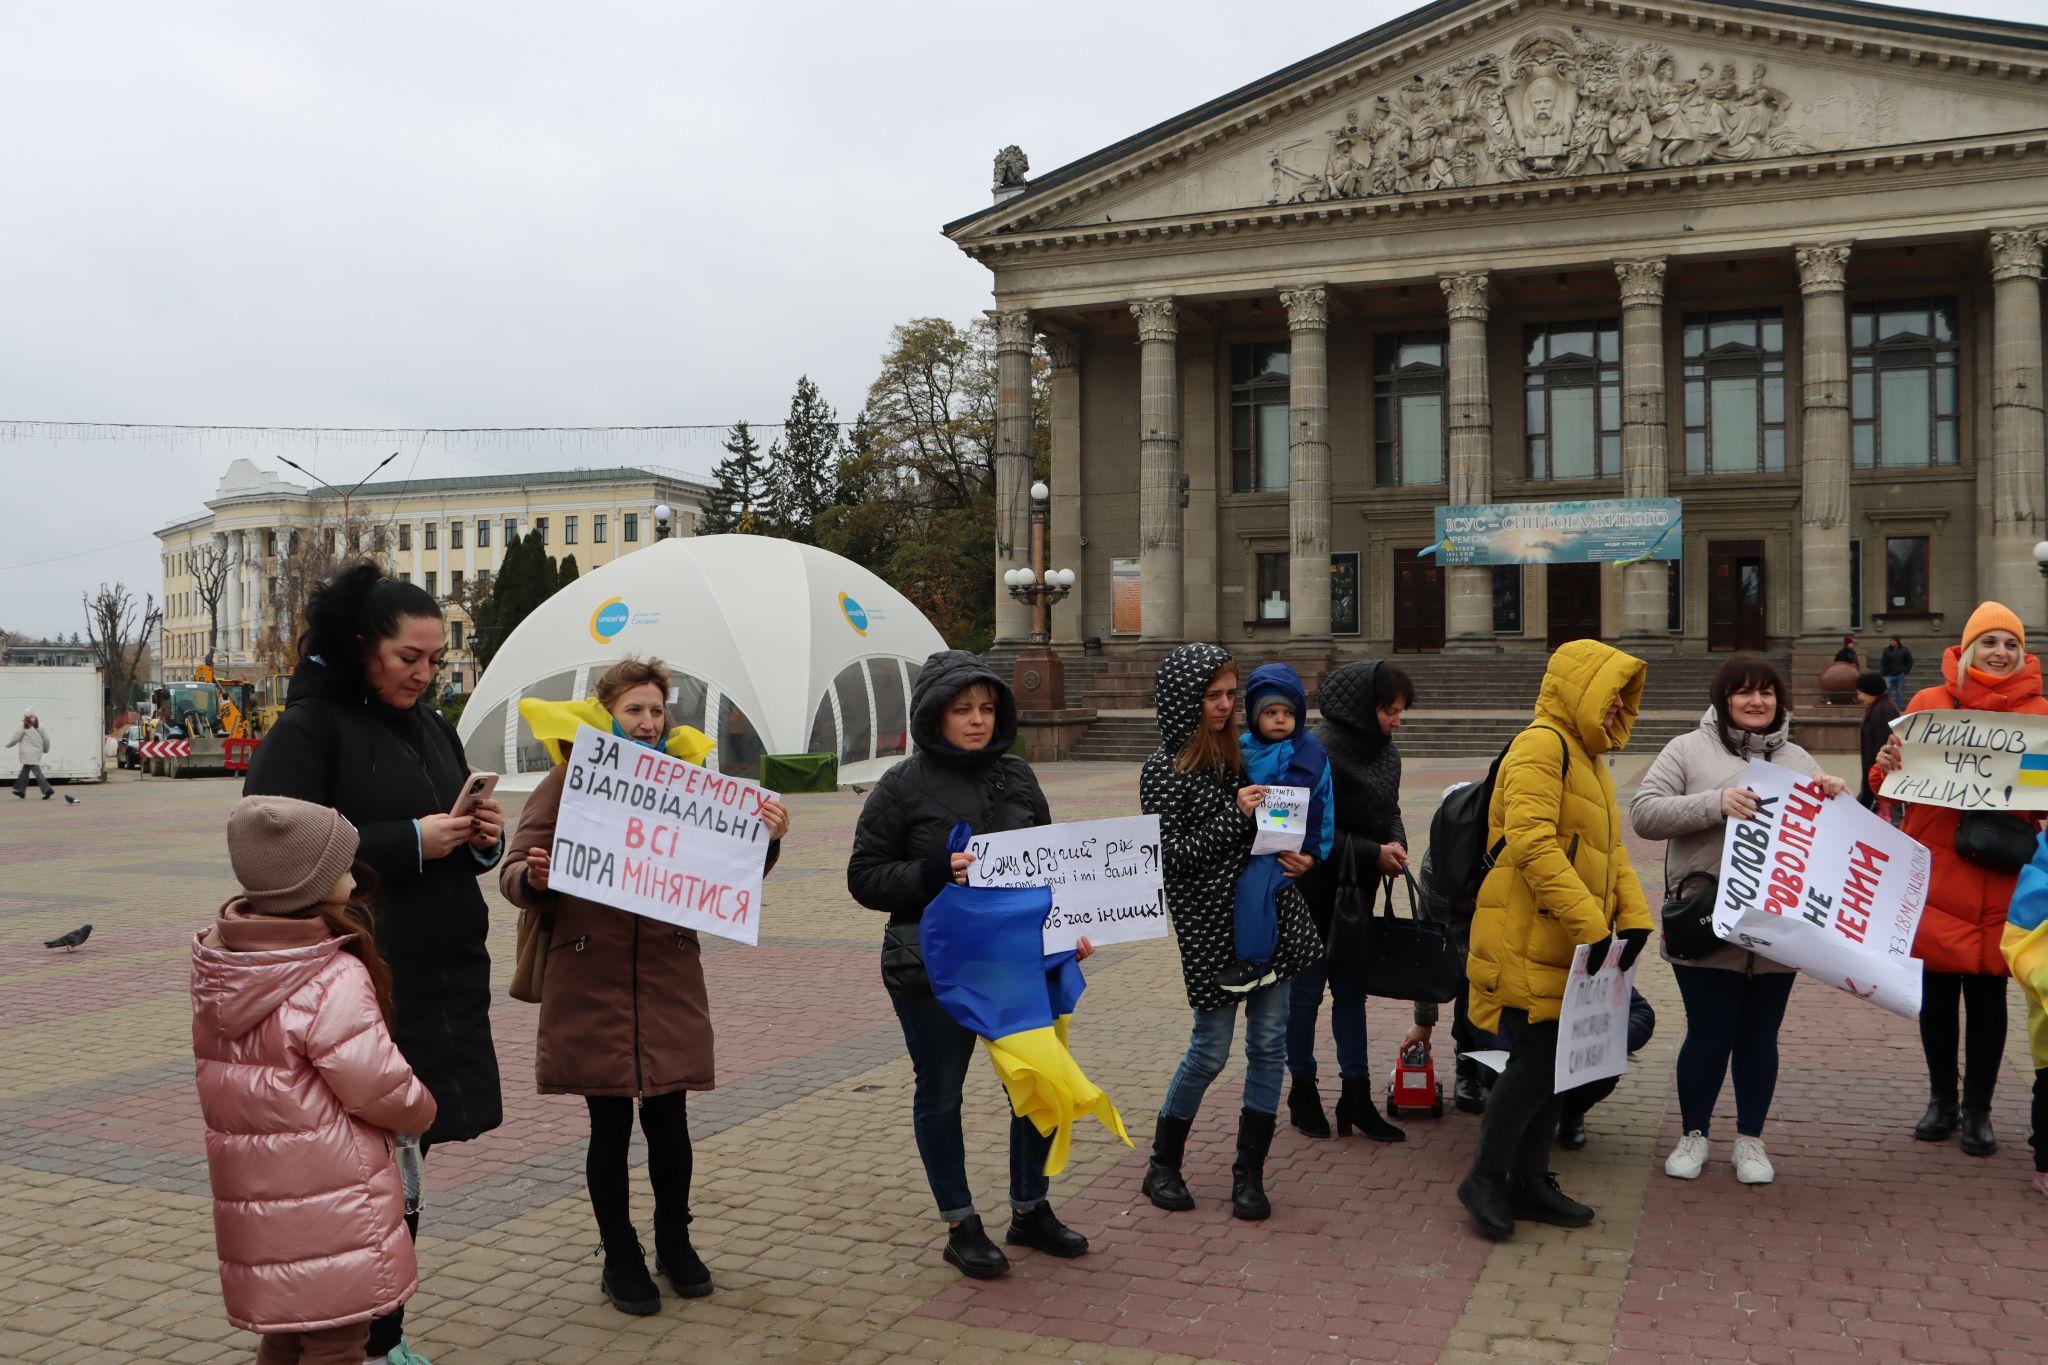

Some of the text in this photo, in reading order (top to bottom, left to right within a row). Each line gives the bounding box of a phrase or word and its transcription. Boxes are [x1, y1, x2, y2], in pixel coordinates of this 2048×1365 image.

[1445, 516, 1487, 533] ІСУС
[1590, 510, 1669, 529] ЖИВОГО
[588, 736, 772, 818] ЗА ПЕРЕМОГУ
[1945, 751, 1993, 779] ЧАС
[568, 764, 763, 844] ВІДПОВІДАЛЬНІ
[625, 816, 680, 859] ВСІ
[972, 837, 1134, 880] Чому другий рік
[553, 837, 751, 925] ПОРА МІНЯТИСЯ
[1064, 913, 1093, 926] час
[1802, 886, 1834, 929] НЕ
